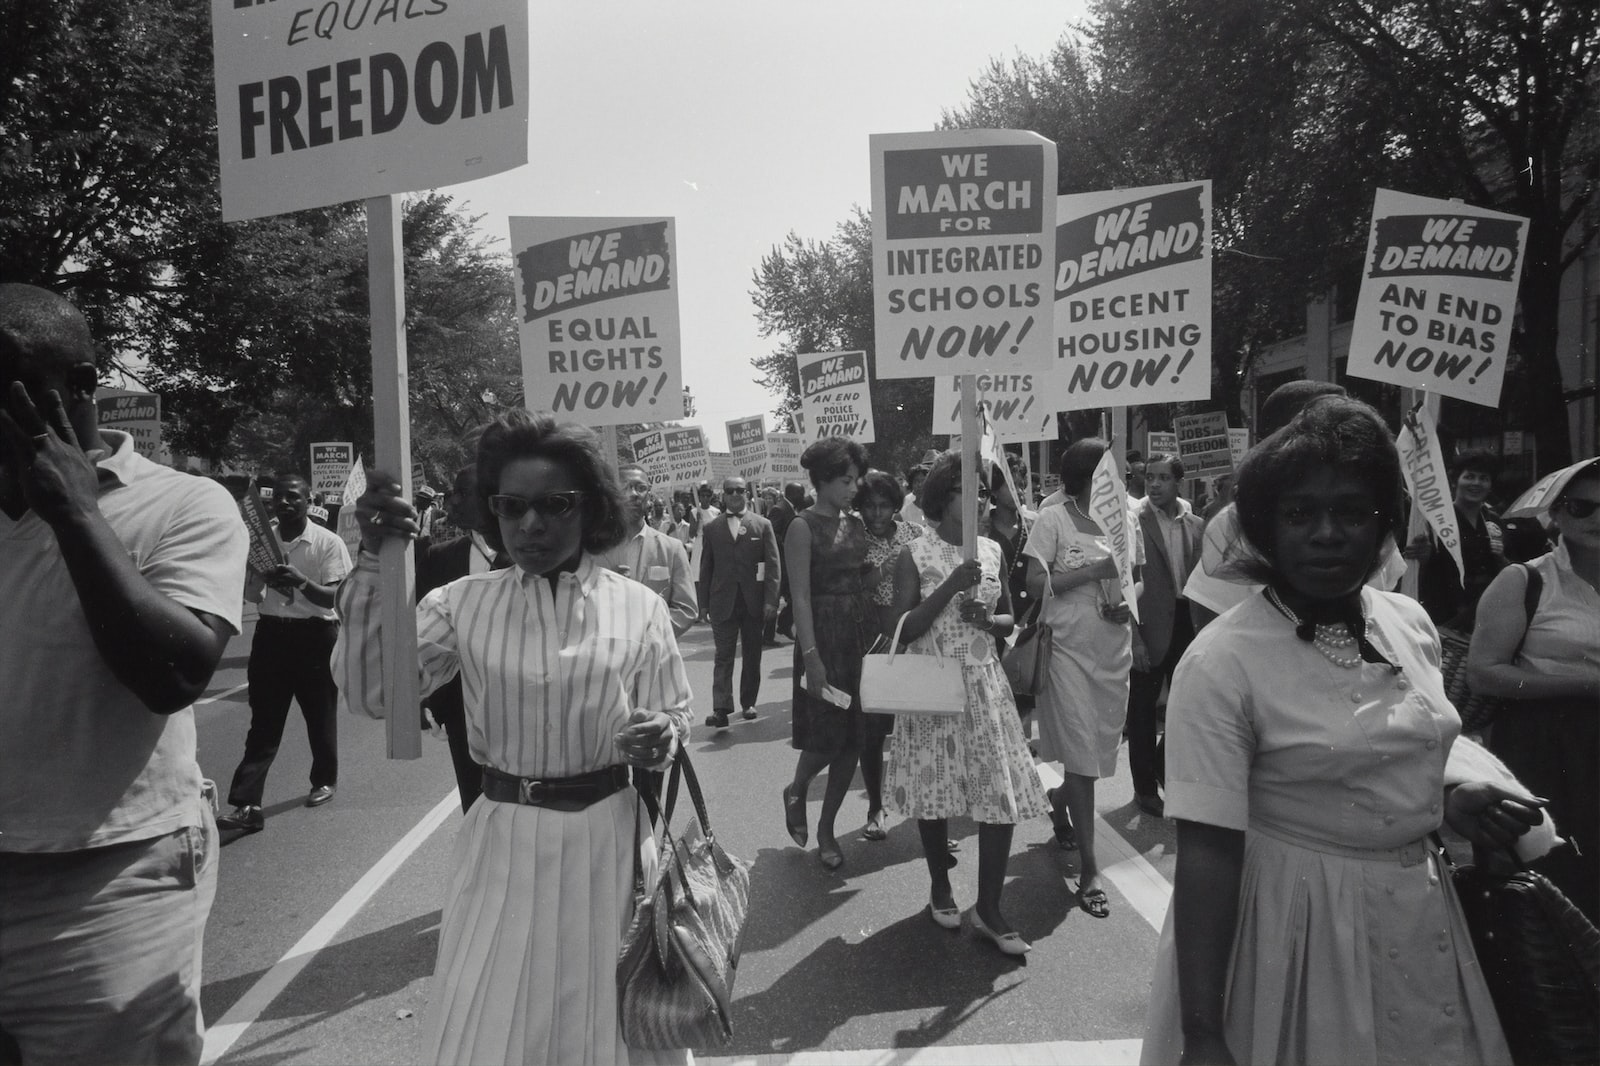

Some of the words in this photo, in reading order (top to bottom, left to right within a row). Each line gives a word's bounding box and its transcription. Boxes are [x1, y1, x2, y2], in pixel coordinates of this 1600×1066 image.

[239, 24, 514, 160] FREEDOM
[941, 154, 988, 177] WE
[898, 181, 1031, 214] MARCH
[940, 217, 991, 231] FOR
[1094, 202, 1152, 245] WE
[1422, 218, 1477, 243] WE
[569, 232, 621, 269] WE
[887, 244, 1042, 275] INTEGRATED
[1056, 222, 1198, 291] DEMAND
[1379, 244, 1513, 272] DEMAND
[533, 254, 664, 311] DEMAND
[888, 283, 1041, 313] SCHOOLS
[1070, 289, 1189, 322] DECENT
[1379, 283, 1427, 310] AN
[1437, 293, 1502, 325] END
[548, 317, 657, 343] EQUAL
[900, 316, 1034, 360] NOW!
[1058, 324, 1201, 358] HOUSING
[1380, 310, 1418, 336] TO
[1427, 319, 1496, 353] BIAS
[549, 346, 663, 373] RIGHTS
[822, 357, 844, 374] WE
[1067, 348, 1194, 394] NOW!
[1374, 340, 1492, 385] NOW!
[807, 366, 862, 393] DEMAND
[953, 375, 1032, 392] RGHTS
[116, 397, 138, 408] WE
[552, 371, 668, 413] NOW!
[813, 394, 832, 404] AN
[836, 392, 860, 401] END
[102, 406, 155, 422] DEMAND
[816, 414, 860, 424] BRUTALITY
[824, 405, 853, 415] POLICE
[733, 428, 760, 441] MARCH
[741, 422, 751, 430] WE
[817, 419, 867, 439] NOW!
[1180, 419, 1199, 427] UAW
[1180, 426, 1211, 441] JOBS
[645, 433, 660, 446] WE
[669, 437, 700, 448] MARCH
[733, 448, 748, 458] FIRST
[749, 444, 766, 454] CLASS
[1181, 438, 1228, 455] FREEDOM
[316, 452, 348, 460] MARCH
[669, 450, 705, 461] INTEGRATED
[671, 459, 707, 470] SCHOOLS
[733, 452, 767, 467] CITIZENSHIP
[1413, 422, 1444, 512] FREEDOM
[676, 466, 706, 481] NOW!
[740, 462, 767, 477] NOW!
[771, 464, 798, 472] REEDOM
[242, 495, 261, 529] MARCH
[1092, 469, 1125, 555] FREEDOM
[1435, 513, 1445, 524] IN
[1439, 523, 1457, 548] '63
